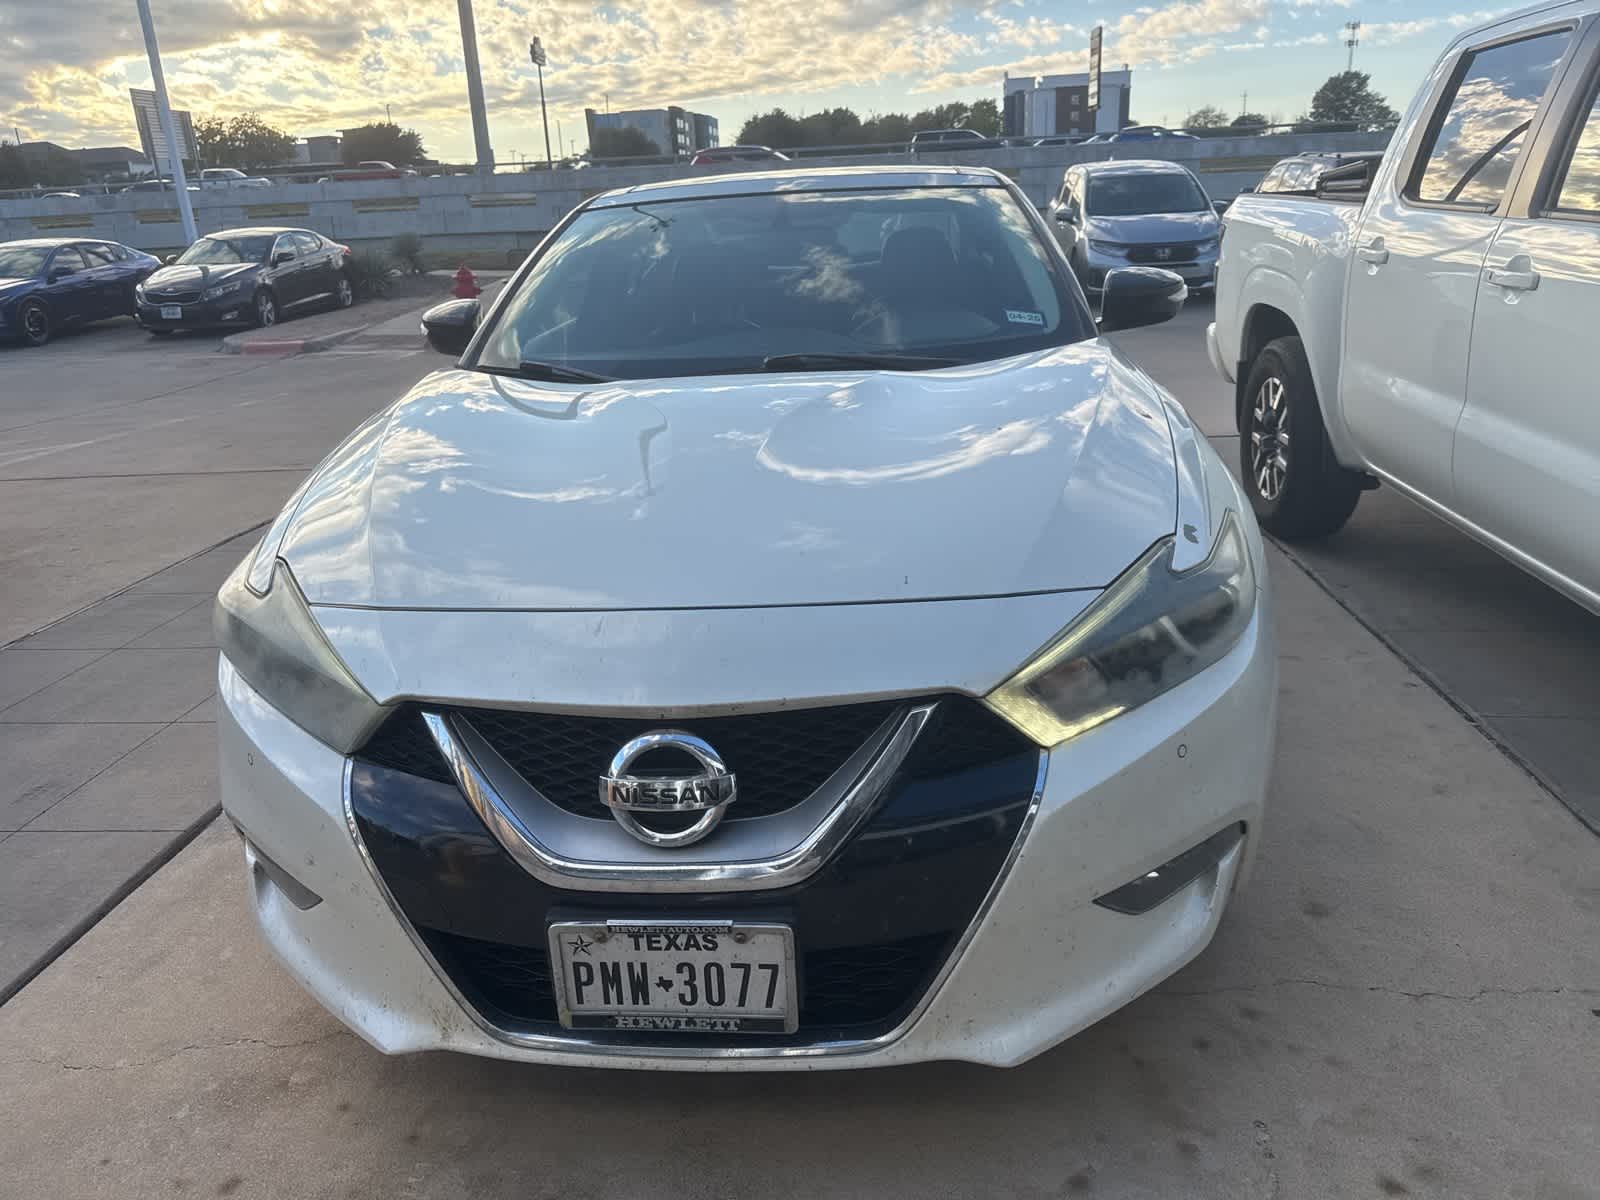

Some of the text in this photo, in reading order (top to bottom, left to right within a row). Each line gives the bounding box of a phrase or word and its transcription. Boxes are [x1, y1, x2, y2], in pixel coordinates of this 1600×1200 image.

[611, 785, 720, 805] NISSAN
[627, 933, 719, 951] TEXAS
[571, 961, 780, 1009] PMW 3077
[615, 1016, 741, 1031] HEWLETT
